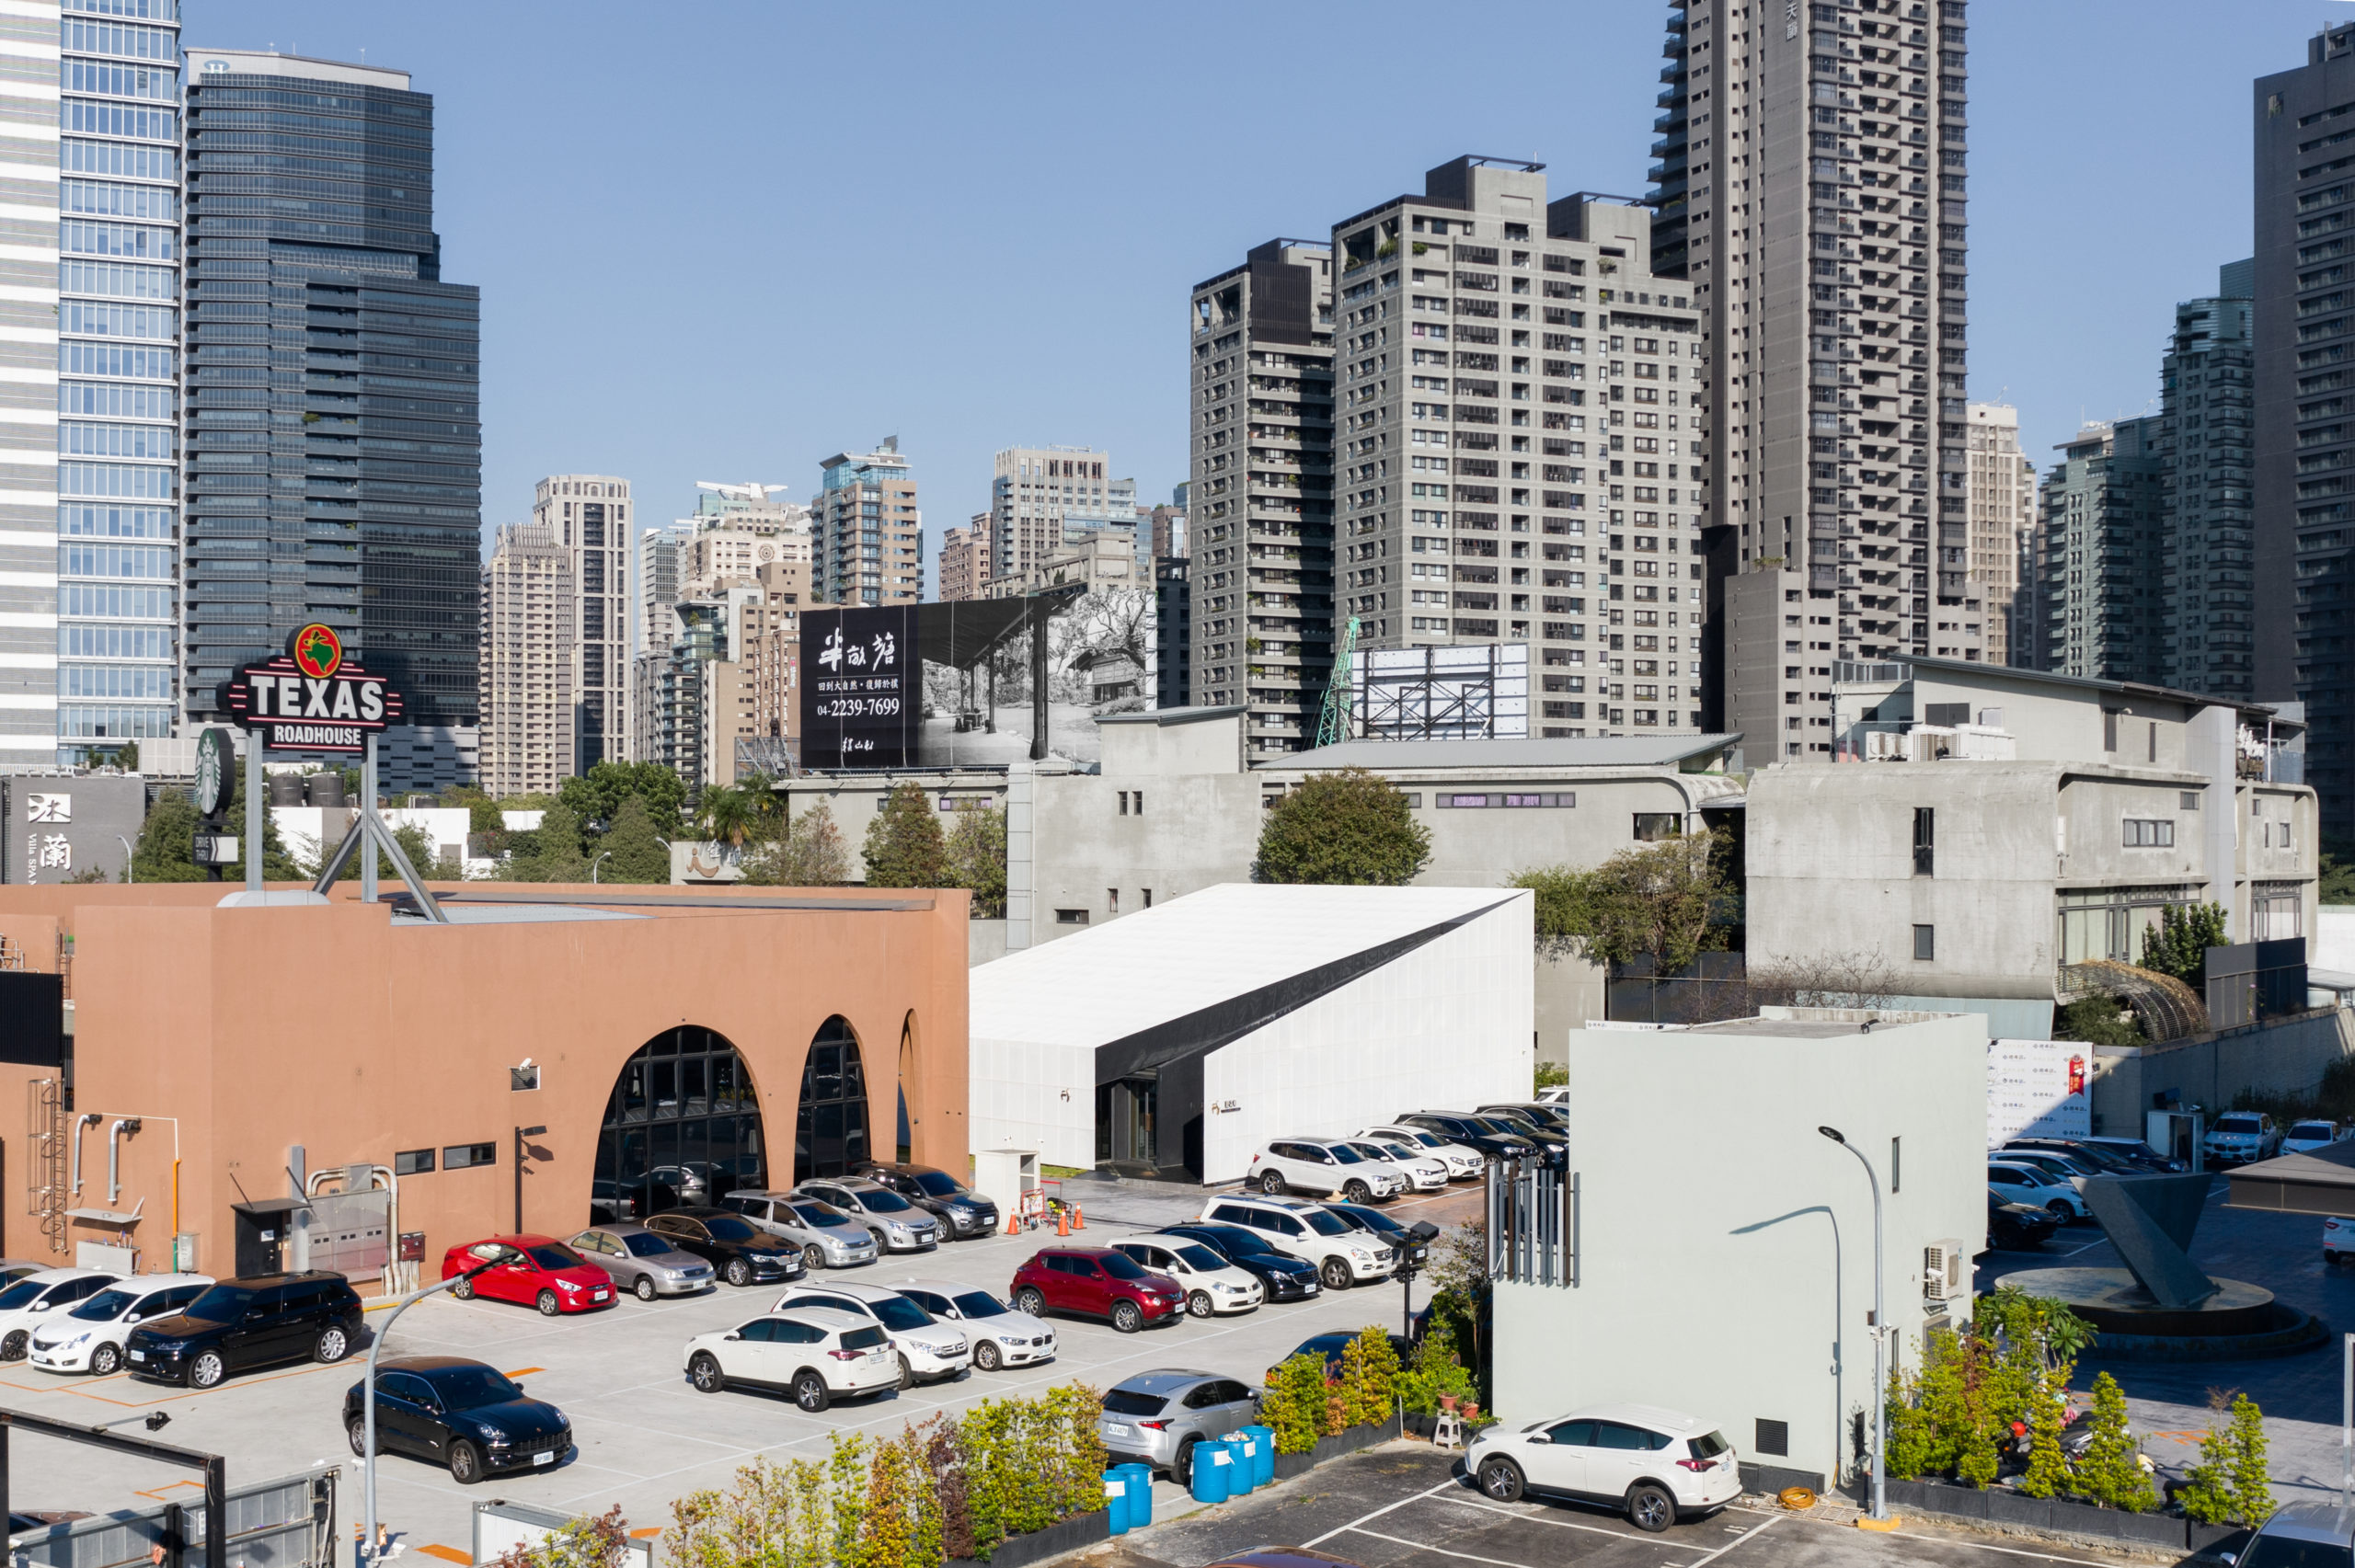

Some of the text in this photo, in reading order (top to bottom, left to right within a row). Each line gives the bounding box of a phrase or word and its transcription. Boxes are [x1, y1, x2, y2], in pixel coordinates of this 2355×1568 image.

[250, 675, 384, 721] TEXAS
[817, 698, 900, 717] 04-2239-7699
[274, 725, 362, 746] ROADHOUSE
[29, 832, 38, 855] Villa
[195, 836, 209, 847] DRIVE
[195, 850, 209, 862] THRU
